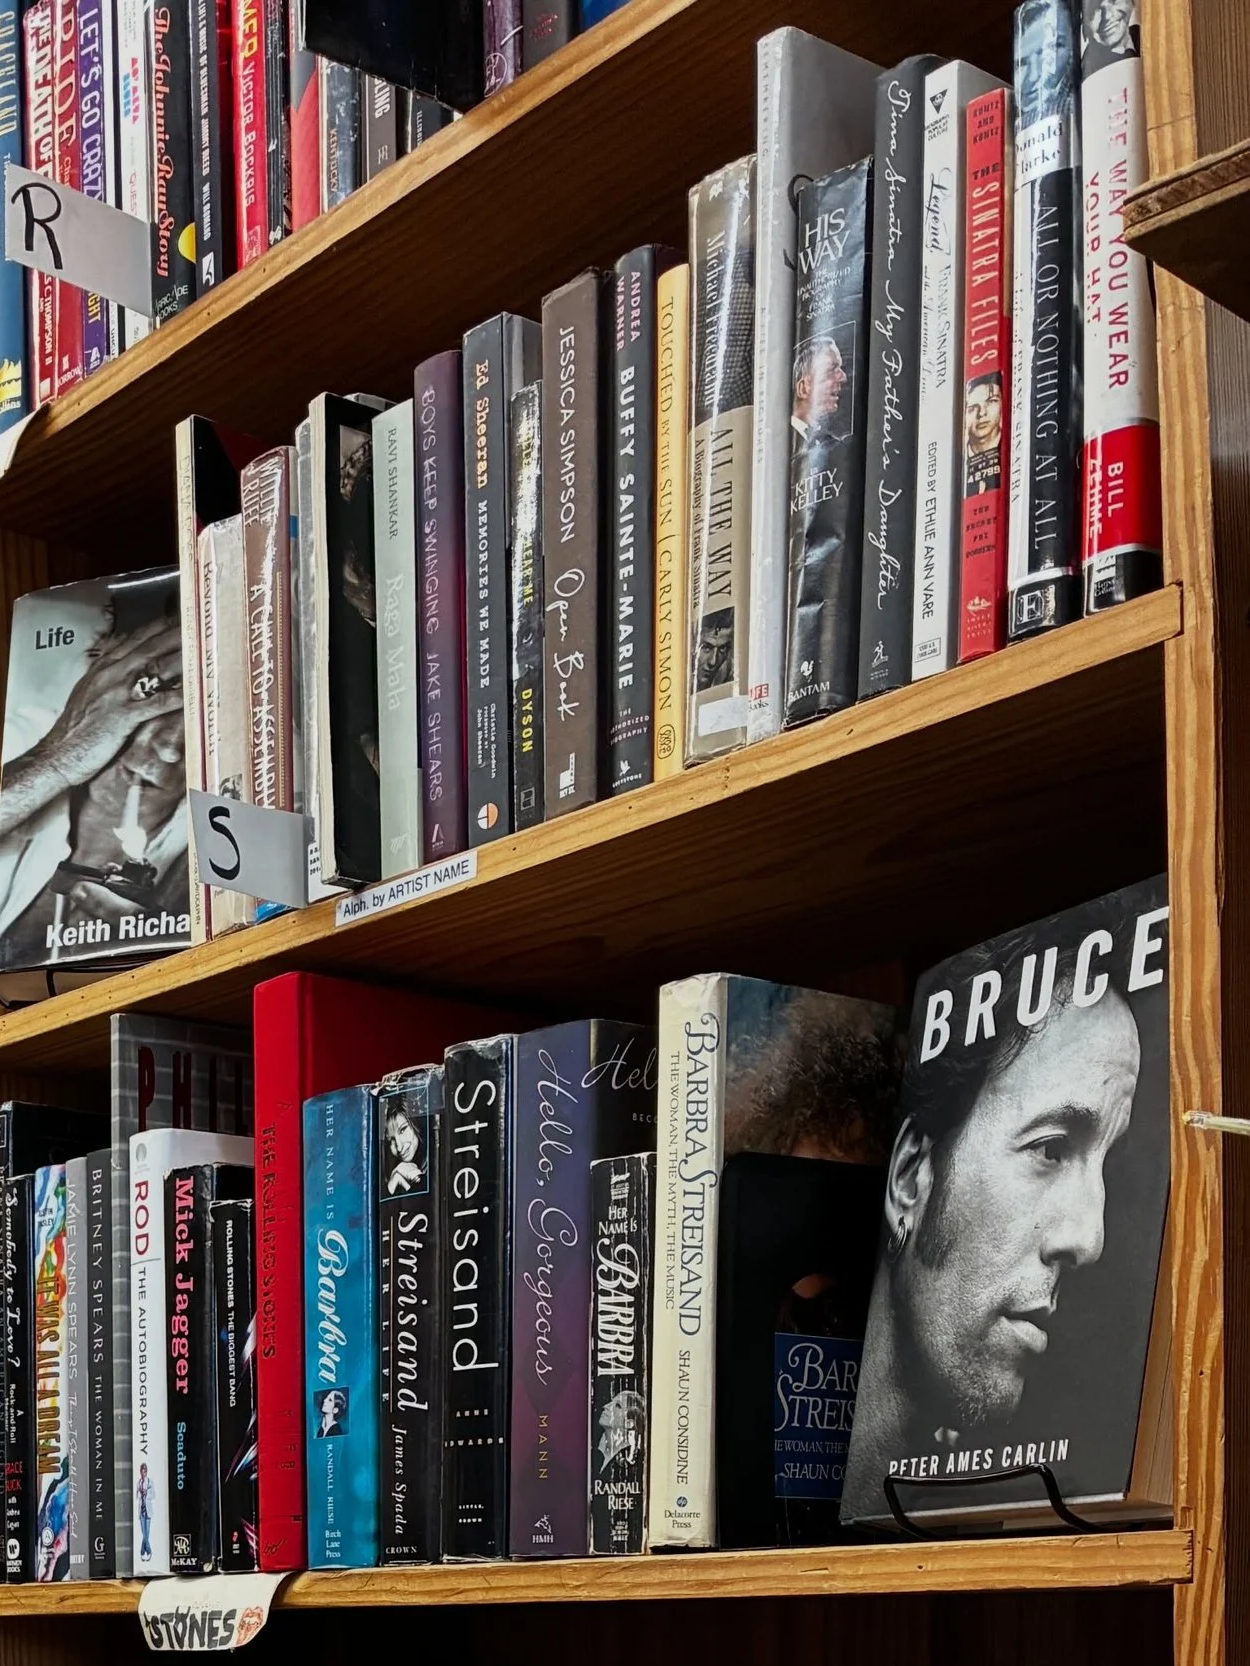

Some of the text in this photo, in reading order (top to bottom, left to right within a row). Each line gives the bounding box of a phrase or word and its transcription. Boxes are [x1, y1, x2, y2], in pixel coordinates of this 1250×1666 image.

[973, 164, 1000, 180] THE
[11, 182, 63, 270] R
[798, 232, 850, 275] WAY
[804, 207, 847, 249] HIS
[971, 181, 1001, 283] SINATRA
[1108, 89, 1128, 389] THE WAY YOU WEAR
[615, 276, 625, 352] WARNER
[629, 270, 641, 343] ANDREA
[970, 289, 999, 366] FILES
[560, 326, 575, 543] JESSICA SIMPSON
[790, 481, 844, 515] KELLEY
[794, 466, 837, 499] KITTY
[1107, 462, 1124, 518] BILL
[617, 365, 635, 689] BUFFY SAINTE-MARIE
[35, 627, 75, 651] Life
[521, 688, 533, 752] DYSON
[208, 805, 241, 881] S
[343, 860, 469, 919] Alph. by ARTIST NAME
[46, 912, 190, 948] Keith Richa
[922, 906, 1169, 1063] BRUCE
[678, 1012, 720, 1338] BARBRA STREISAND
[452, 1078, 498, 1373] Streisand
[524, 1049, 579, 1479] Hello, Gorgeous MANN
[134, 1180, 150, 1456] ROD THE AUTOBIOGRAPHY
[171, 1175, 195, 1491] Mick Jagger Scaduto
[596, 1236, 640, 1377] BARBRA
[392, 1211, 428, 1535] Streisand James Spada
[677, 1349, 689, 1485] SHAUN CONSIDINE
[594, 1479, 641, 1498] RANDALL
[889, 1439, 1068, 1477] PETER AMES CARLIN
[607, 1494, 634, 1511] RIESE
[144, 1610, 236, 1650] STONES
